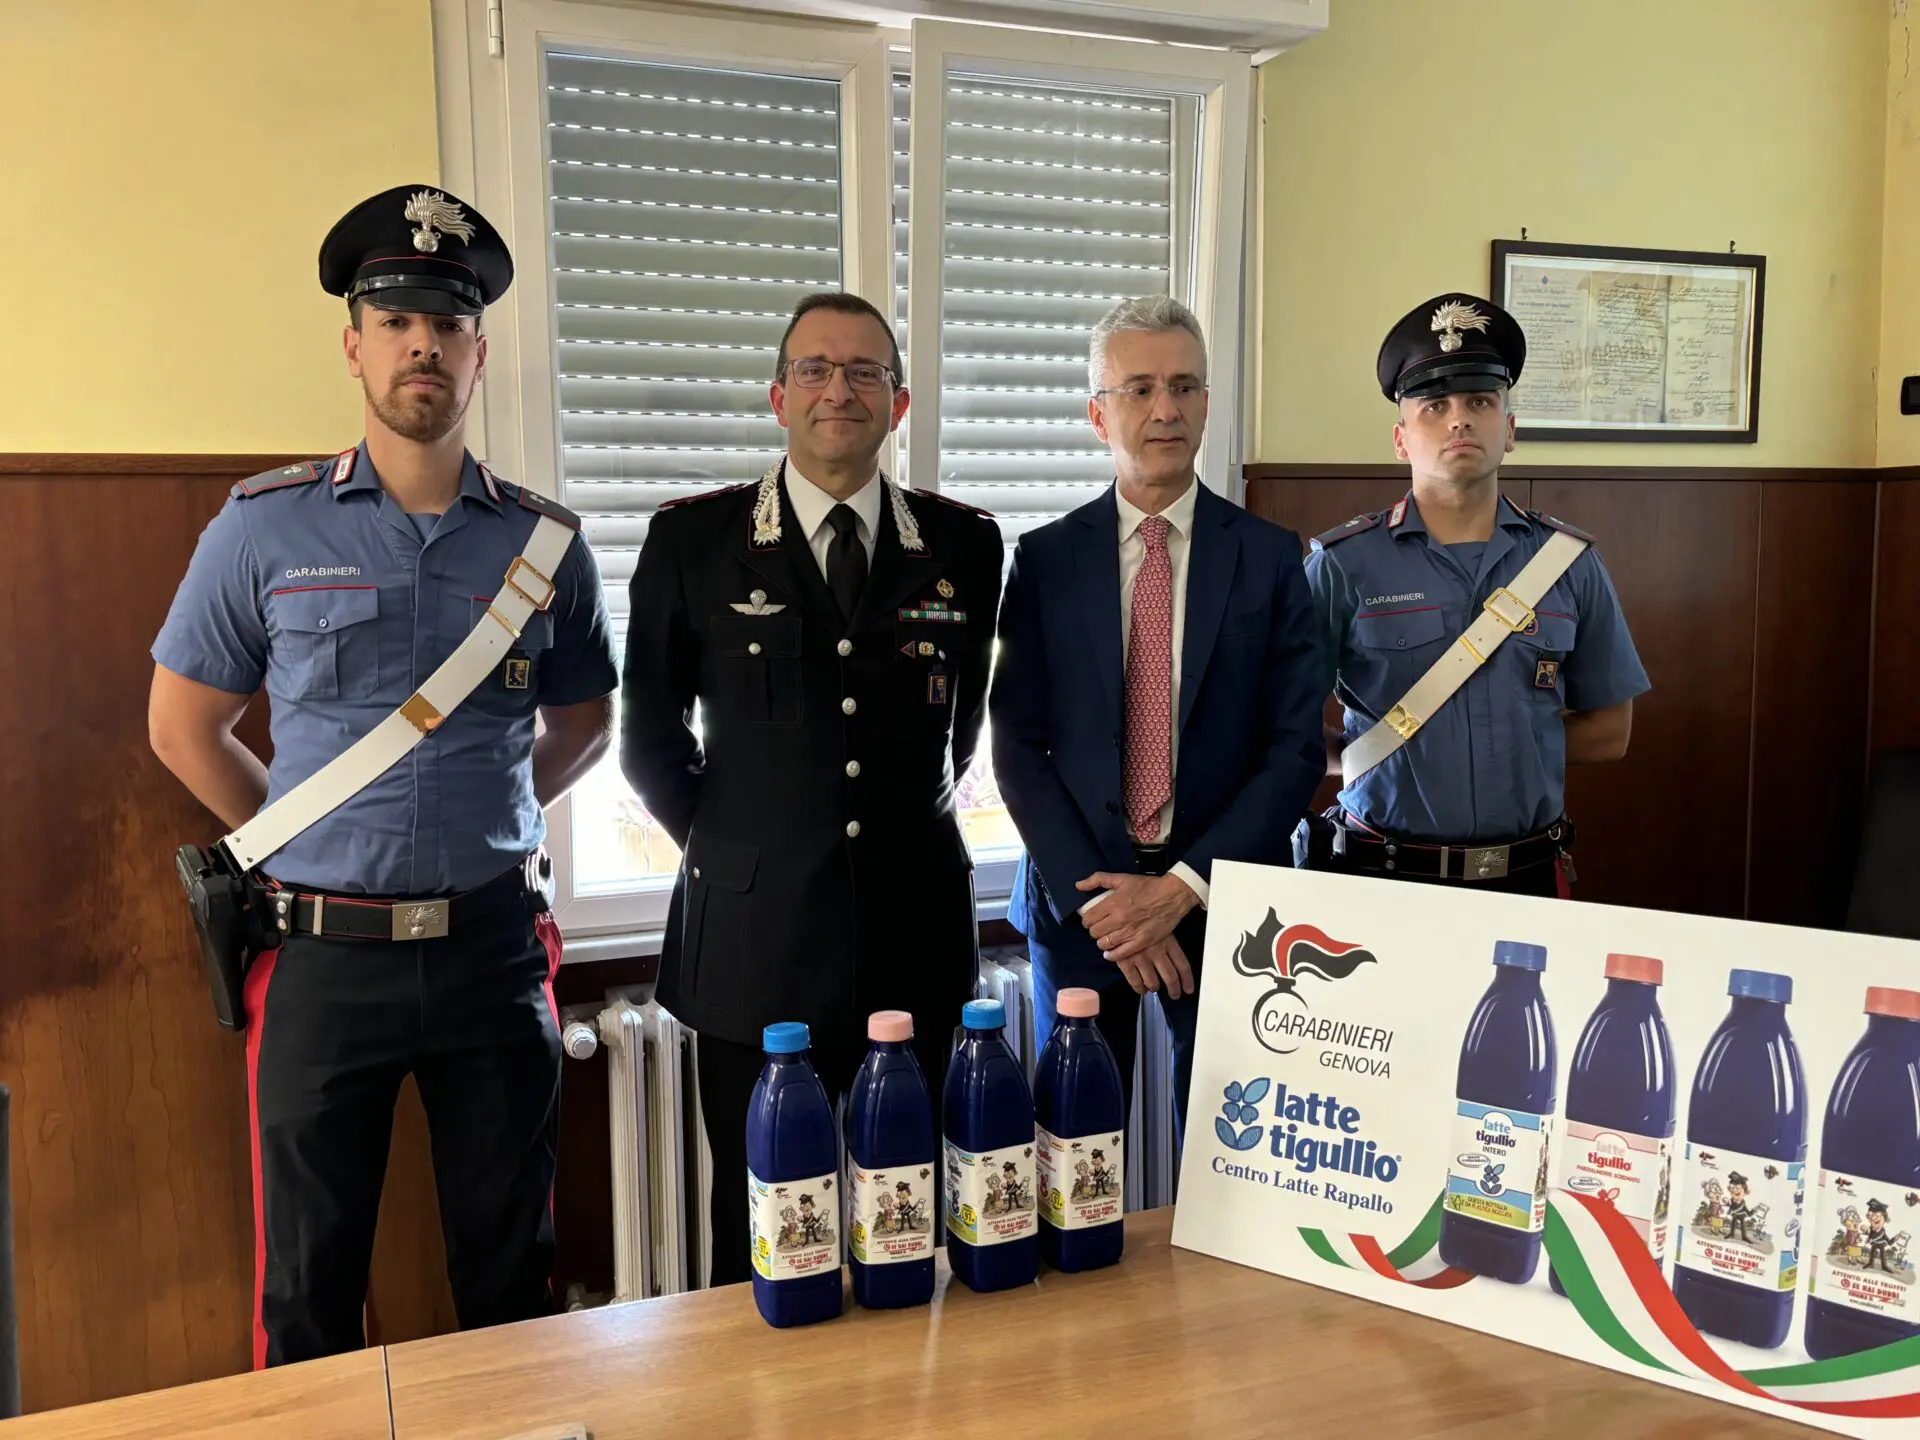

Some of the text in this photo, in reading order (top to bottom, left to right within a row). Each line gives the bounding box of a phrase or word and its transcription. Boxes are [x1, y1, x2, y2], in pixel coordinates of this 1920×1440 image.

[285, 566, 361, 579] CARABINIERI
[1364, 592, 1425, 606] CARABINIERI
[1264, 1009, 1394, 1053] CARABINIERI
[1319, 1050, 1391, 1079] GENOVA
[1274, 1083, 1361, 1134] latte
[1484, 1119, 1511, 1134] latte
[1475, 1130, 1517, 1148] tigullio
[1482, 1145, 1507, 1157] INTERO
[1588, 1152, 1632, 1172] tigullio
[1211, 1156, 1394, 1215] Centro Latte Rapallo
[1696, 1239, 1723, 1252] ATTENTO
[1832, 1269, 1861, 1281] ATTENTO
[1863, 1277, 1878, 1286] ALLE
[1852, 1282, 1860, 1290] SE
[1862, 1284, 1875, 1293] HAI
